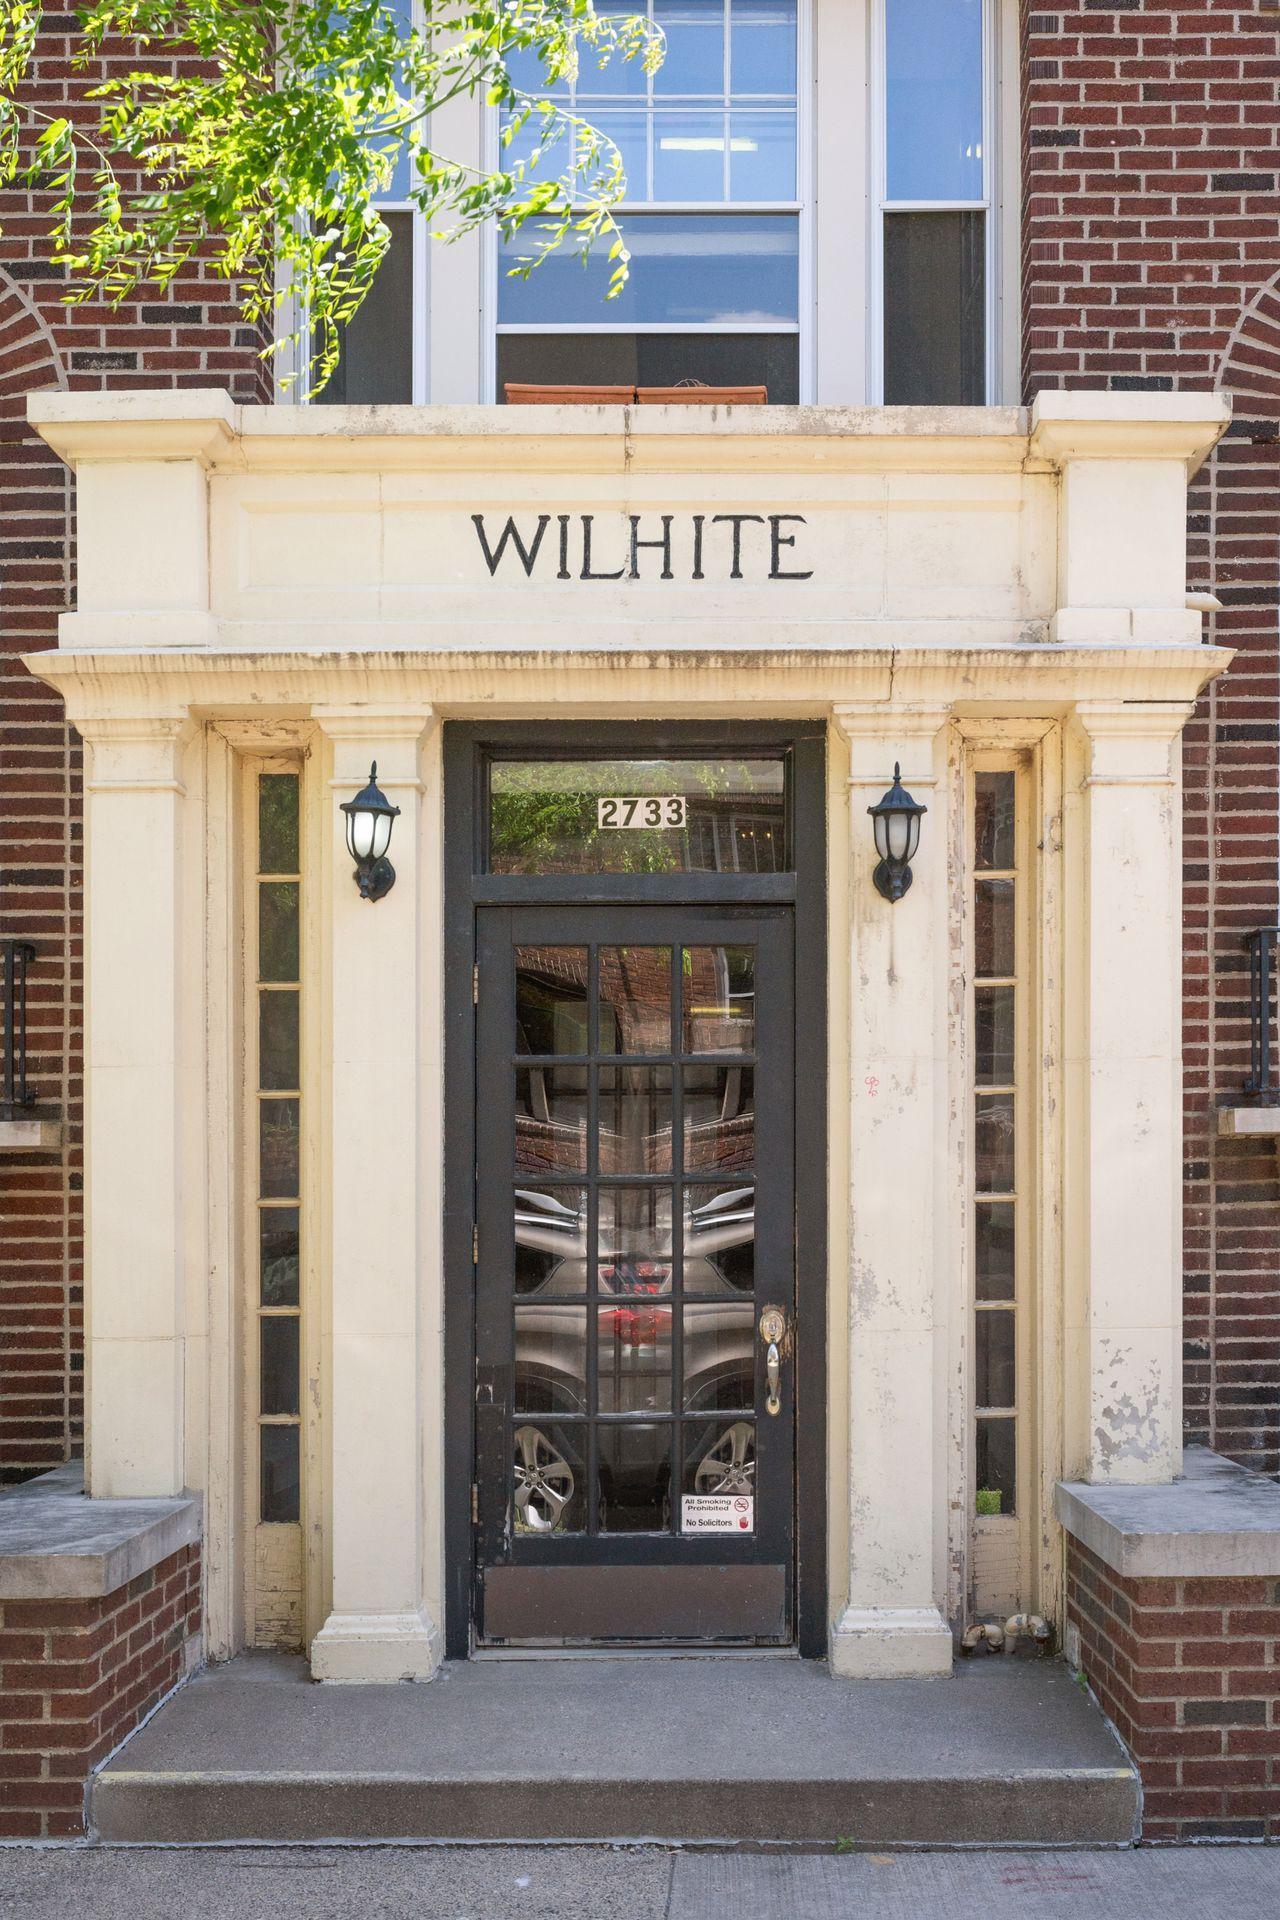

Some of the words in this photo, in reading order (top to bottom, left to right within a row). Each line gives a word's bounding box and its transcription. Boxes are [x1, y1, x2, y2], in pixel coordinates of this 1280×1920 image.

[470, 514, 814, 580] WILHITE
[601, 798, 684, 827] 2733
[697, 1498, 732, 1506] Smoking
[685, 1519, 697, 1527] No
[698, 1518, 733, 1527] Solicitors
